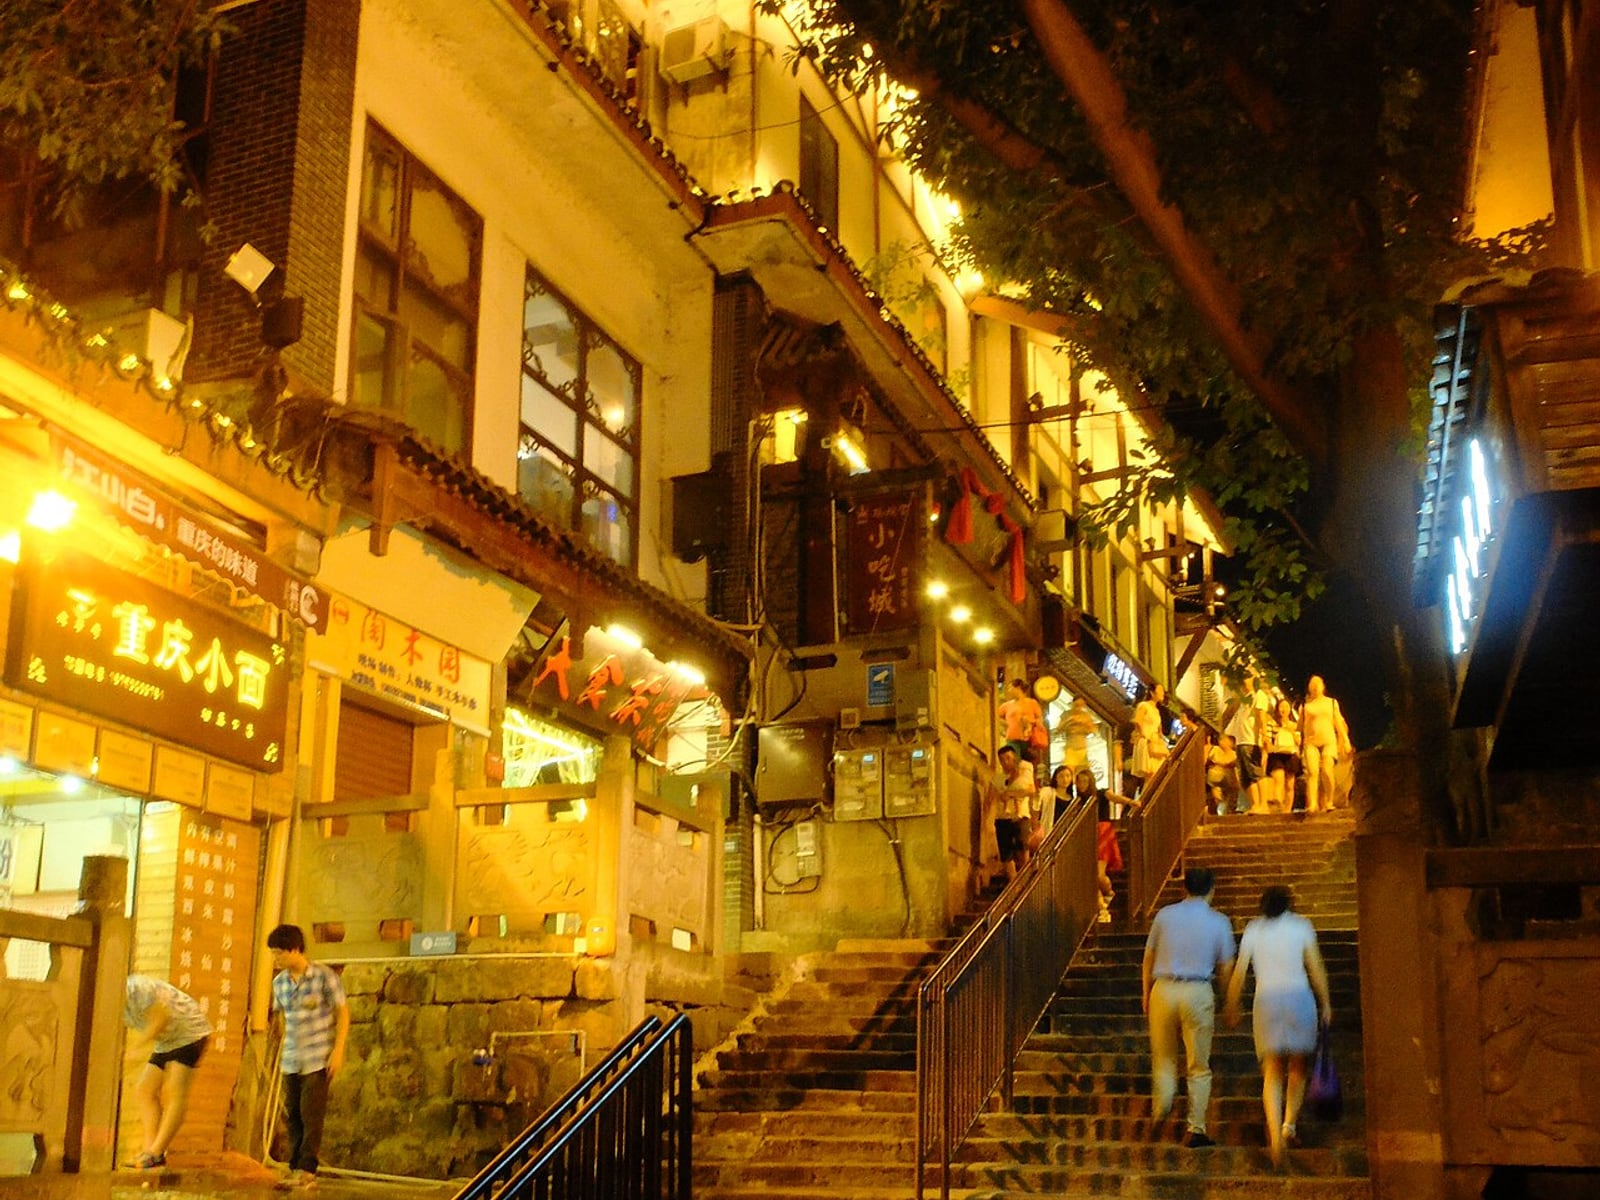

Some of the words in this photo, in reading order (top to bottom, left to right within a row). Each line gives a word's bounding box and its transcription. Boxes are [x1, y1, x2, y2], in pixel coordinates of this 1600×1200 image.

[177, 516, 259, 587] 重庆的味道
[112, 600, 271, 710] 重庆小面
